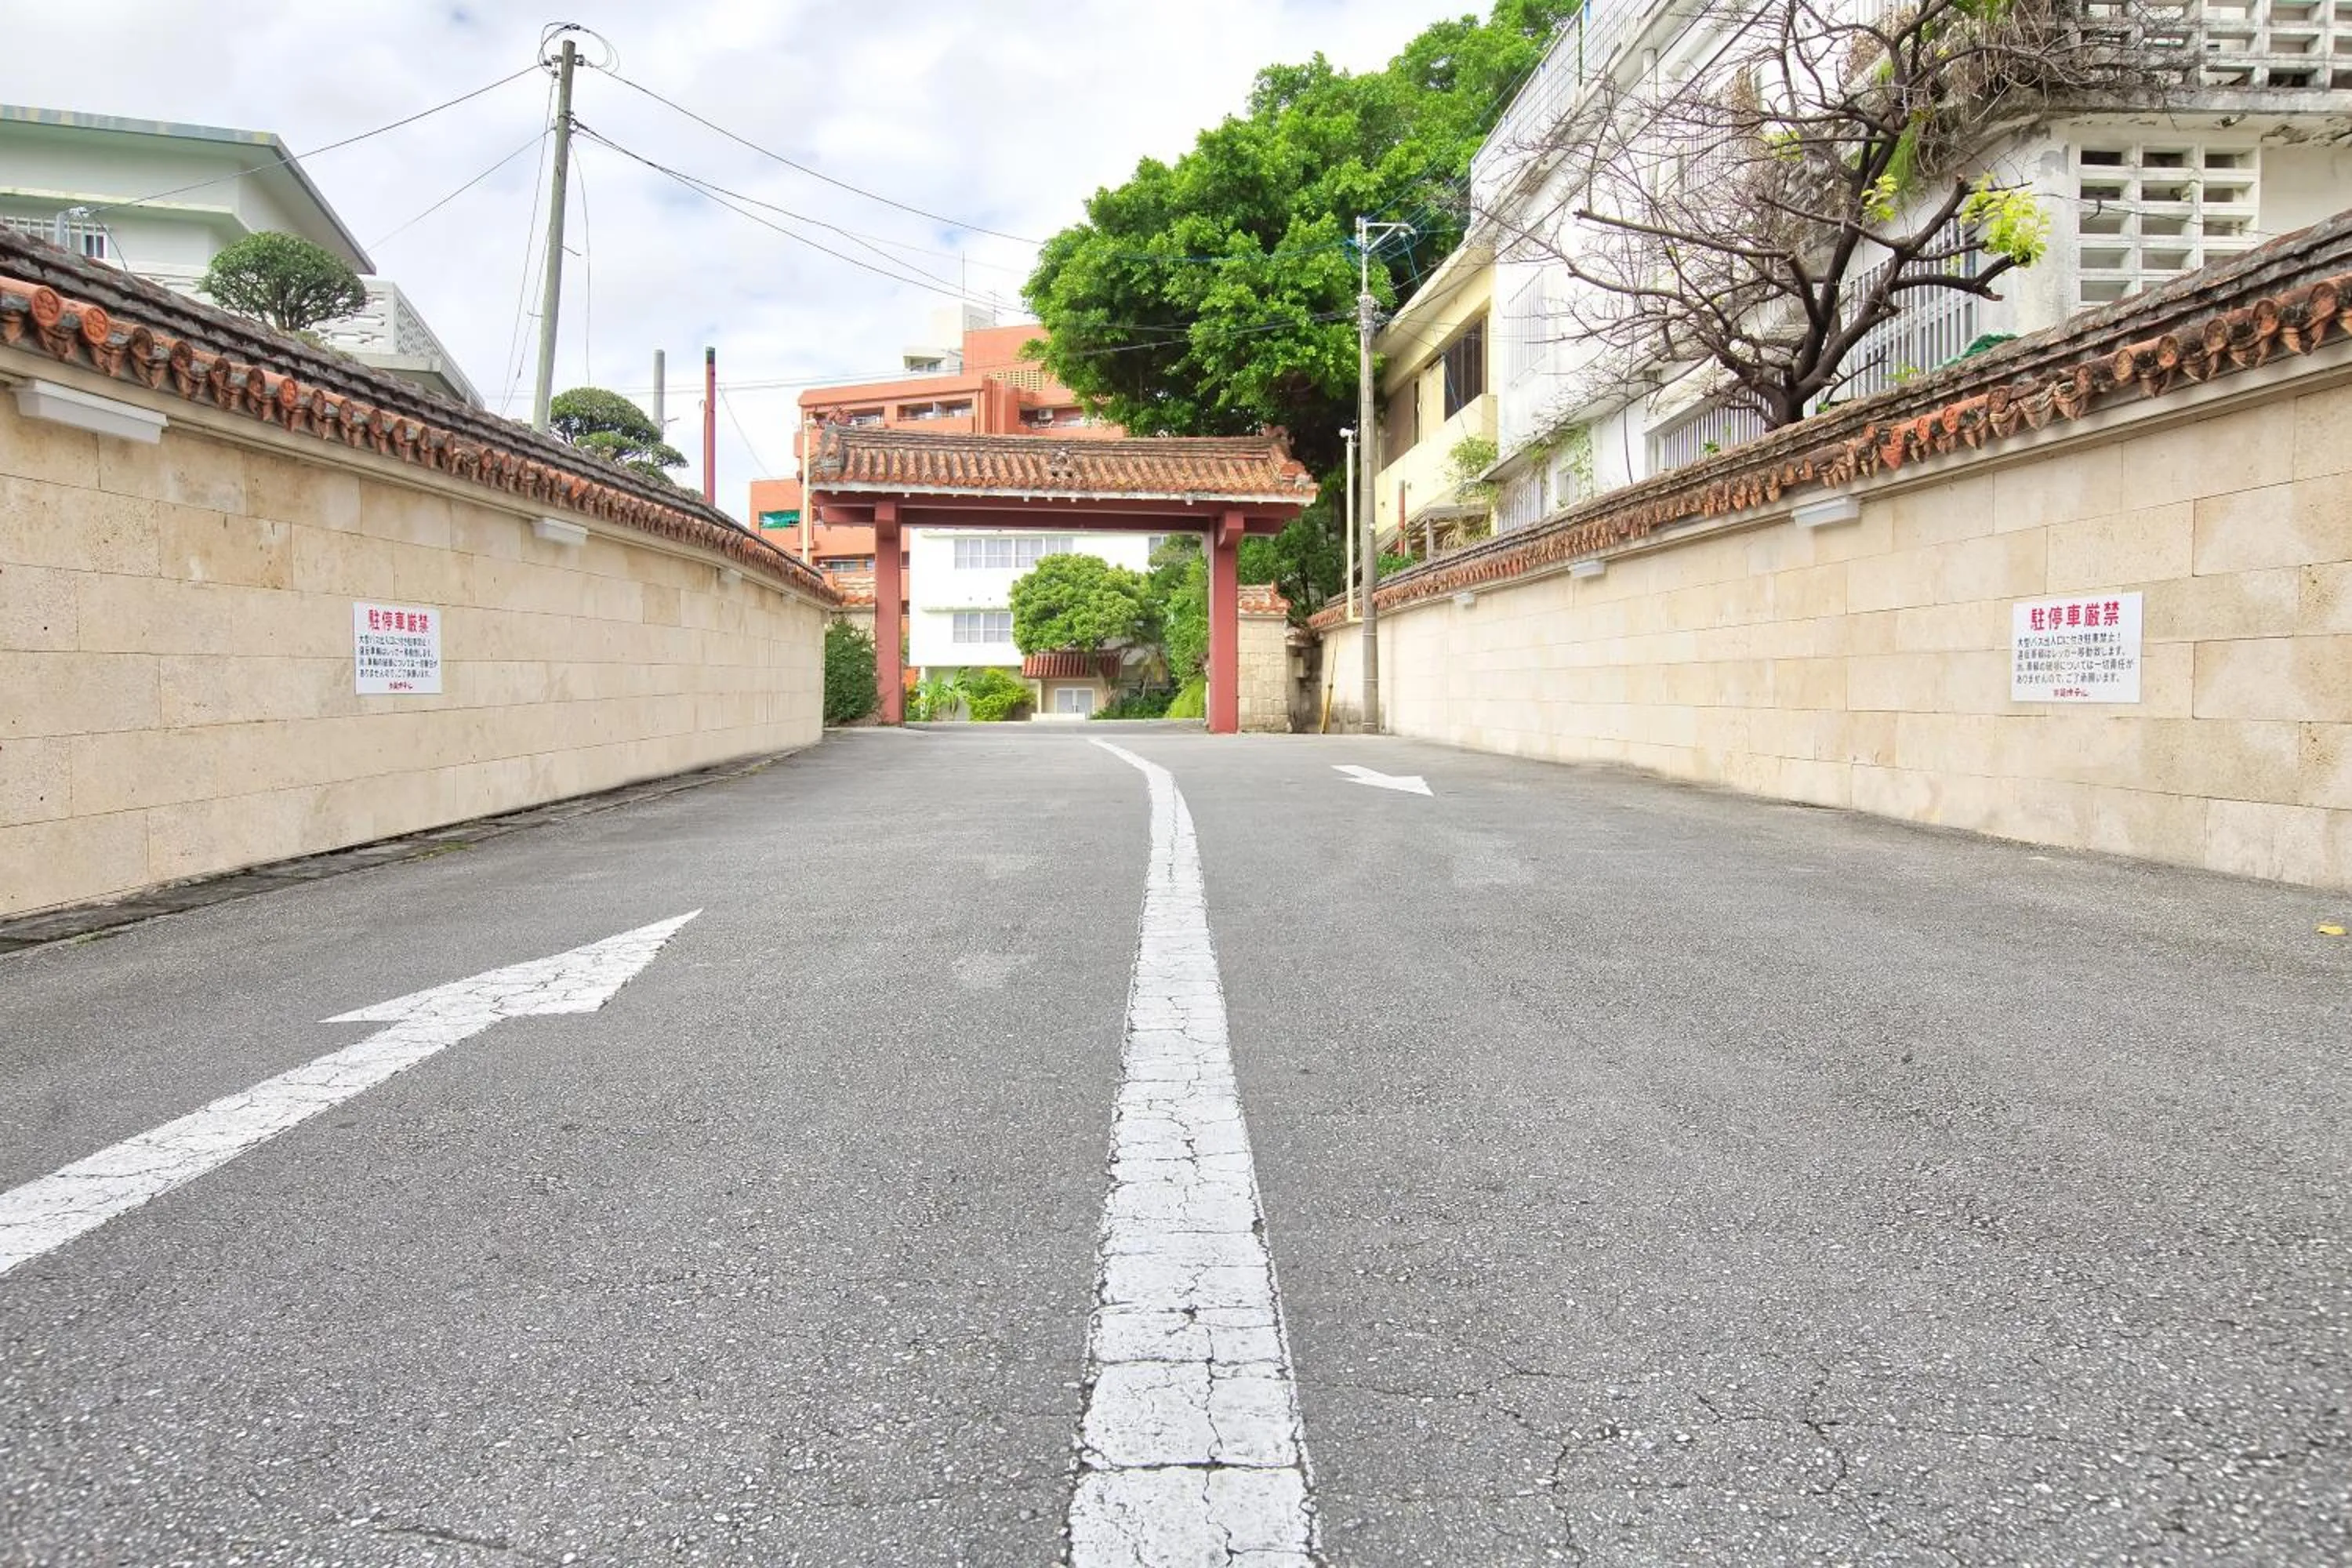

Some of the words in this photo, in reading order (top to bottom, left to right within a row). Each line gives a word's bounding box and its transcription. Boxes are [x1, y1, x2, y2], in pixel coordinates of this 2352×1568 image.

[368, 609, 428, 633] 駐停車厳禁
[2031, 600, 2120, 630] 駐停車厳禁
